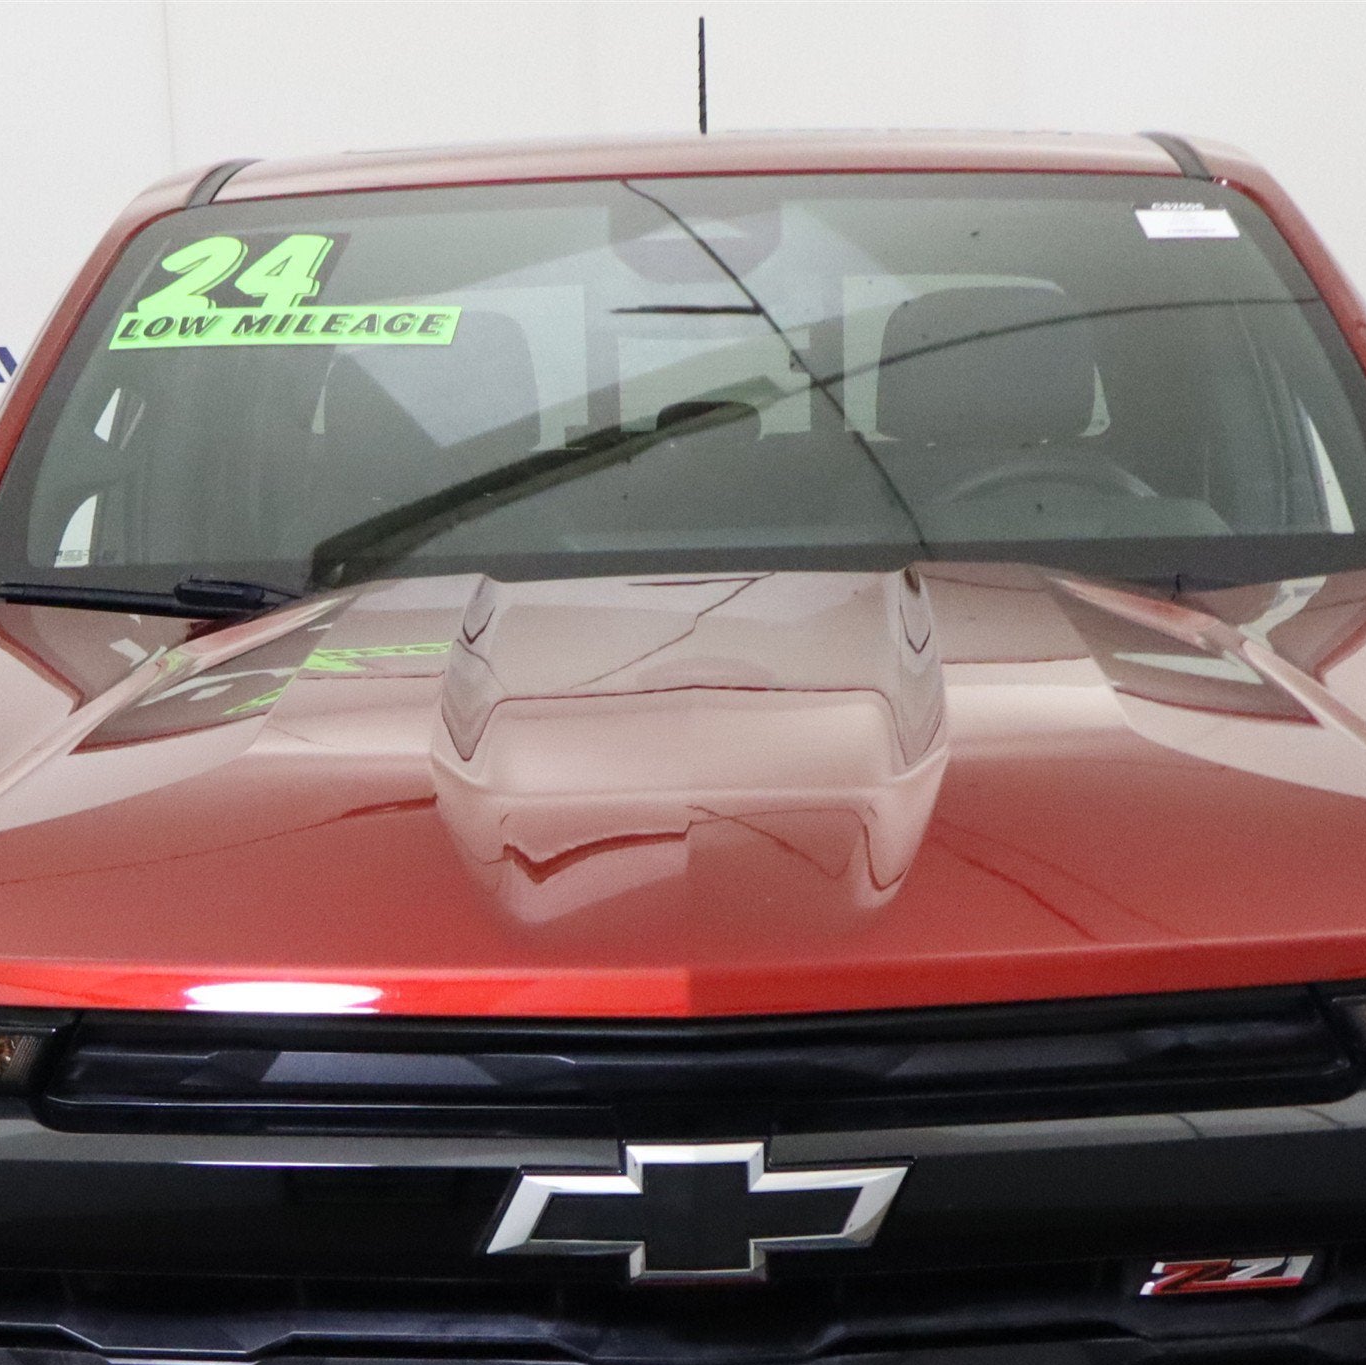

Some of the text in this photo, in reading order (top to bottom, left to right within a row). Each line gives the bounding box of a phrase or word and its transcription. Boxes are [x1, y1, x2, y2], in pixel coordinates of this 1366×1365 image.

[137, 234, 335, 312] 24
[117, 311, 452, 341] LOW MILEAGE
[1139, 1254, 1315, 1297] Z71
